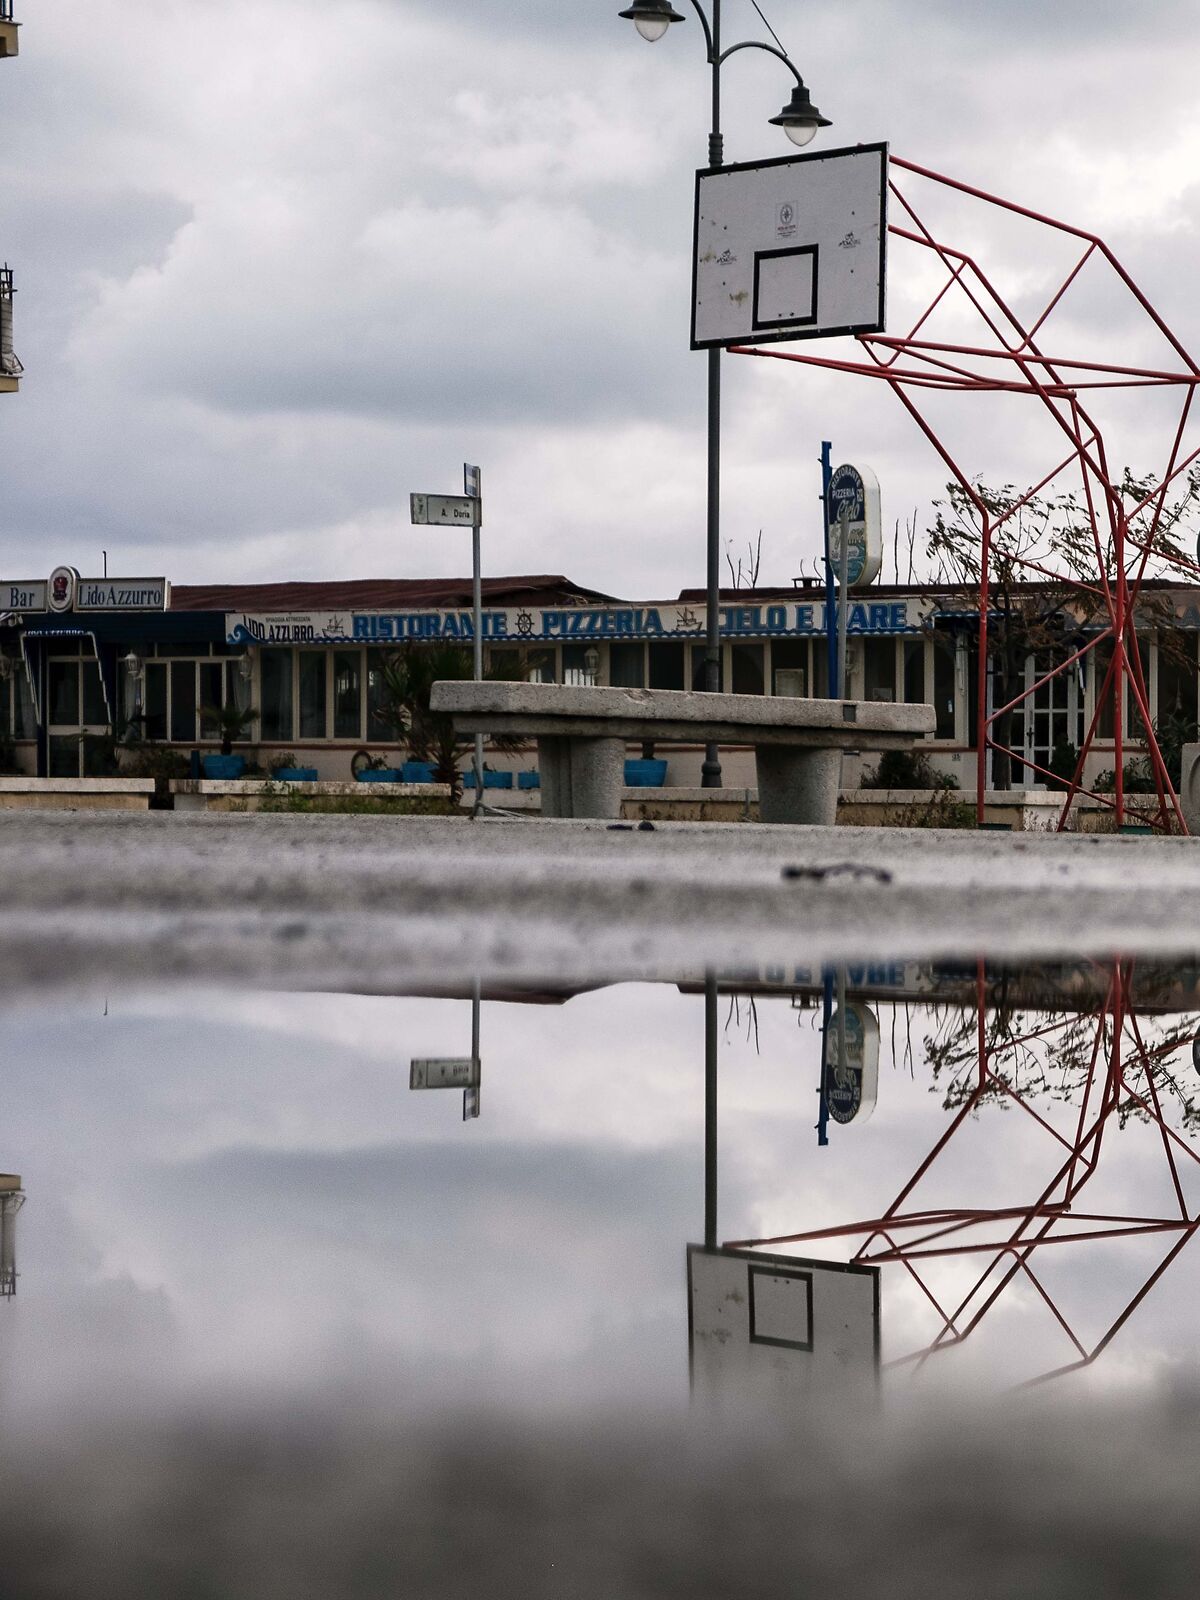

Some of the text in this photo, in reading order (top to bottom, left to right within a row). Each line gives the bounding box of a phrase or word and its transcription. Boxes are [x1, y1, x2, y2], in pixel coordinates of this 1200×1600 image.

[831, 466, 861, 490] RISTORANTE
[832, 488, 856, 499] PIZZERIA
[453, 508, 470, 519] Doria
[10, 587, 35, 607] Bar
[78, 585, 105, 606] Lido
[106, 585, 161, 606] Azzurro
[243, 614, 314, 642] LIDO AZZURRO
[352, 611, 507, 638] RISTORANTE
[541, 608, 664, 636] PIZZERIA
[795, 605, 814, 630] E
